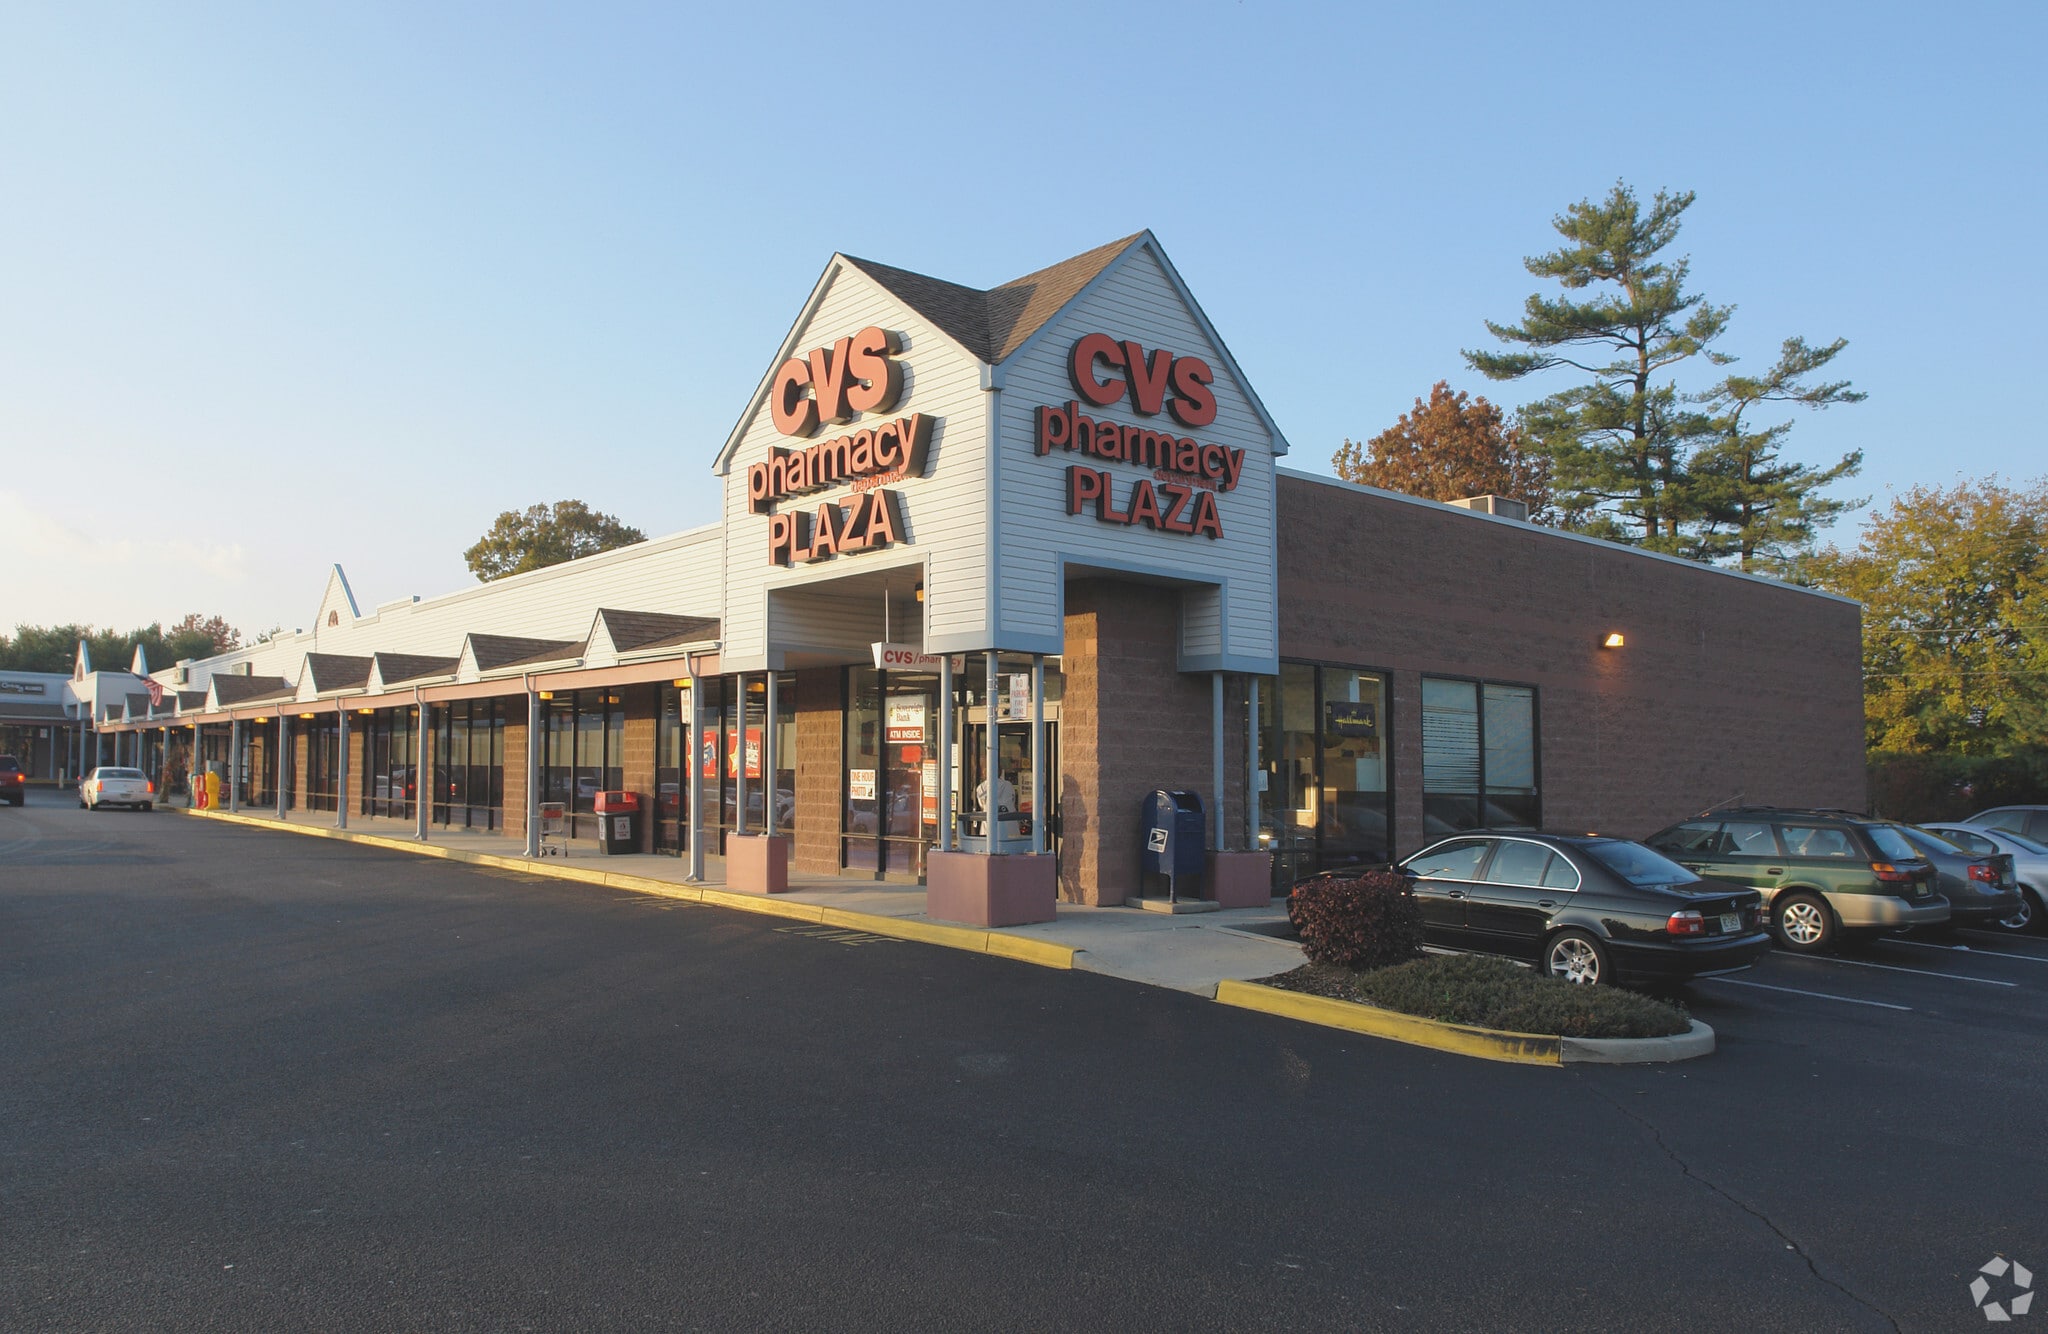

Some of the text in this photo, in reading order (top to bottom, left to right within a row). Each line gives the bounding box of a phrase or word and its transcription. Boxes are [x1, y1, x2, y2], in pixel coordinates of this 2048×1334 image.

[771, 326, 890, 436] CVS
[1067, 333, 1218, 428] CVS
[748, 412, 920, 515] pharmacy
[1035, 400, 1246, 492] pharmacy
[1066, 465, 1224, 540] PLAZA
[769, 489, 895, 567] PLAZA
[884, 650, 962, 668] CVS/pharcy
[890, 730, 921, 739] ATM INSIDE
[896, 712, 910, 721] Bank
[1335, 714, 1373, 729] Hallmark
[851, 771, 875, 782] ONE HOUR
[851, 786, 867, 797] PHOTO
